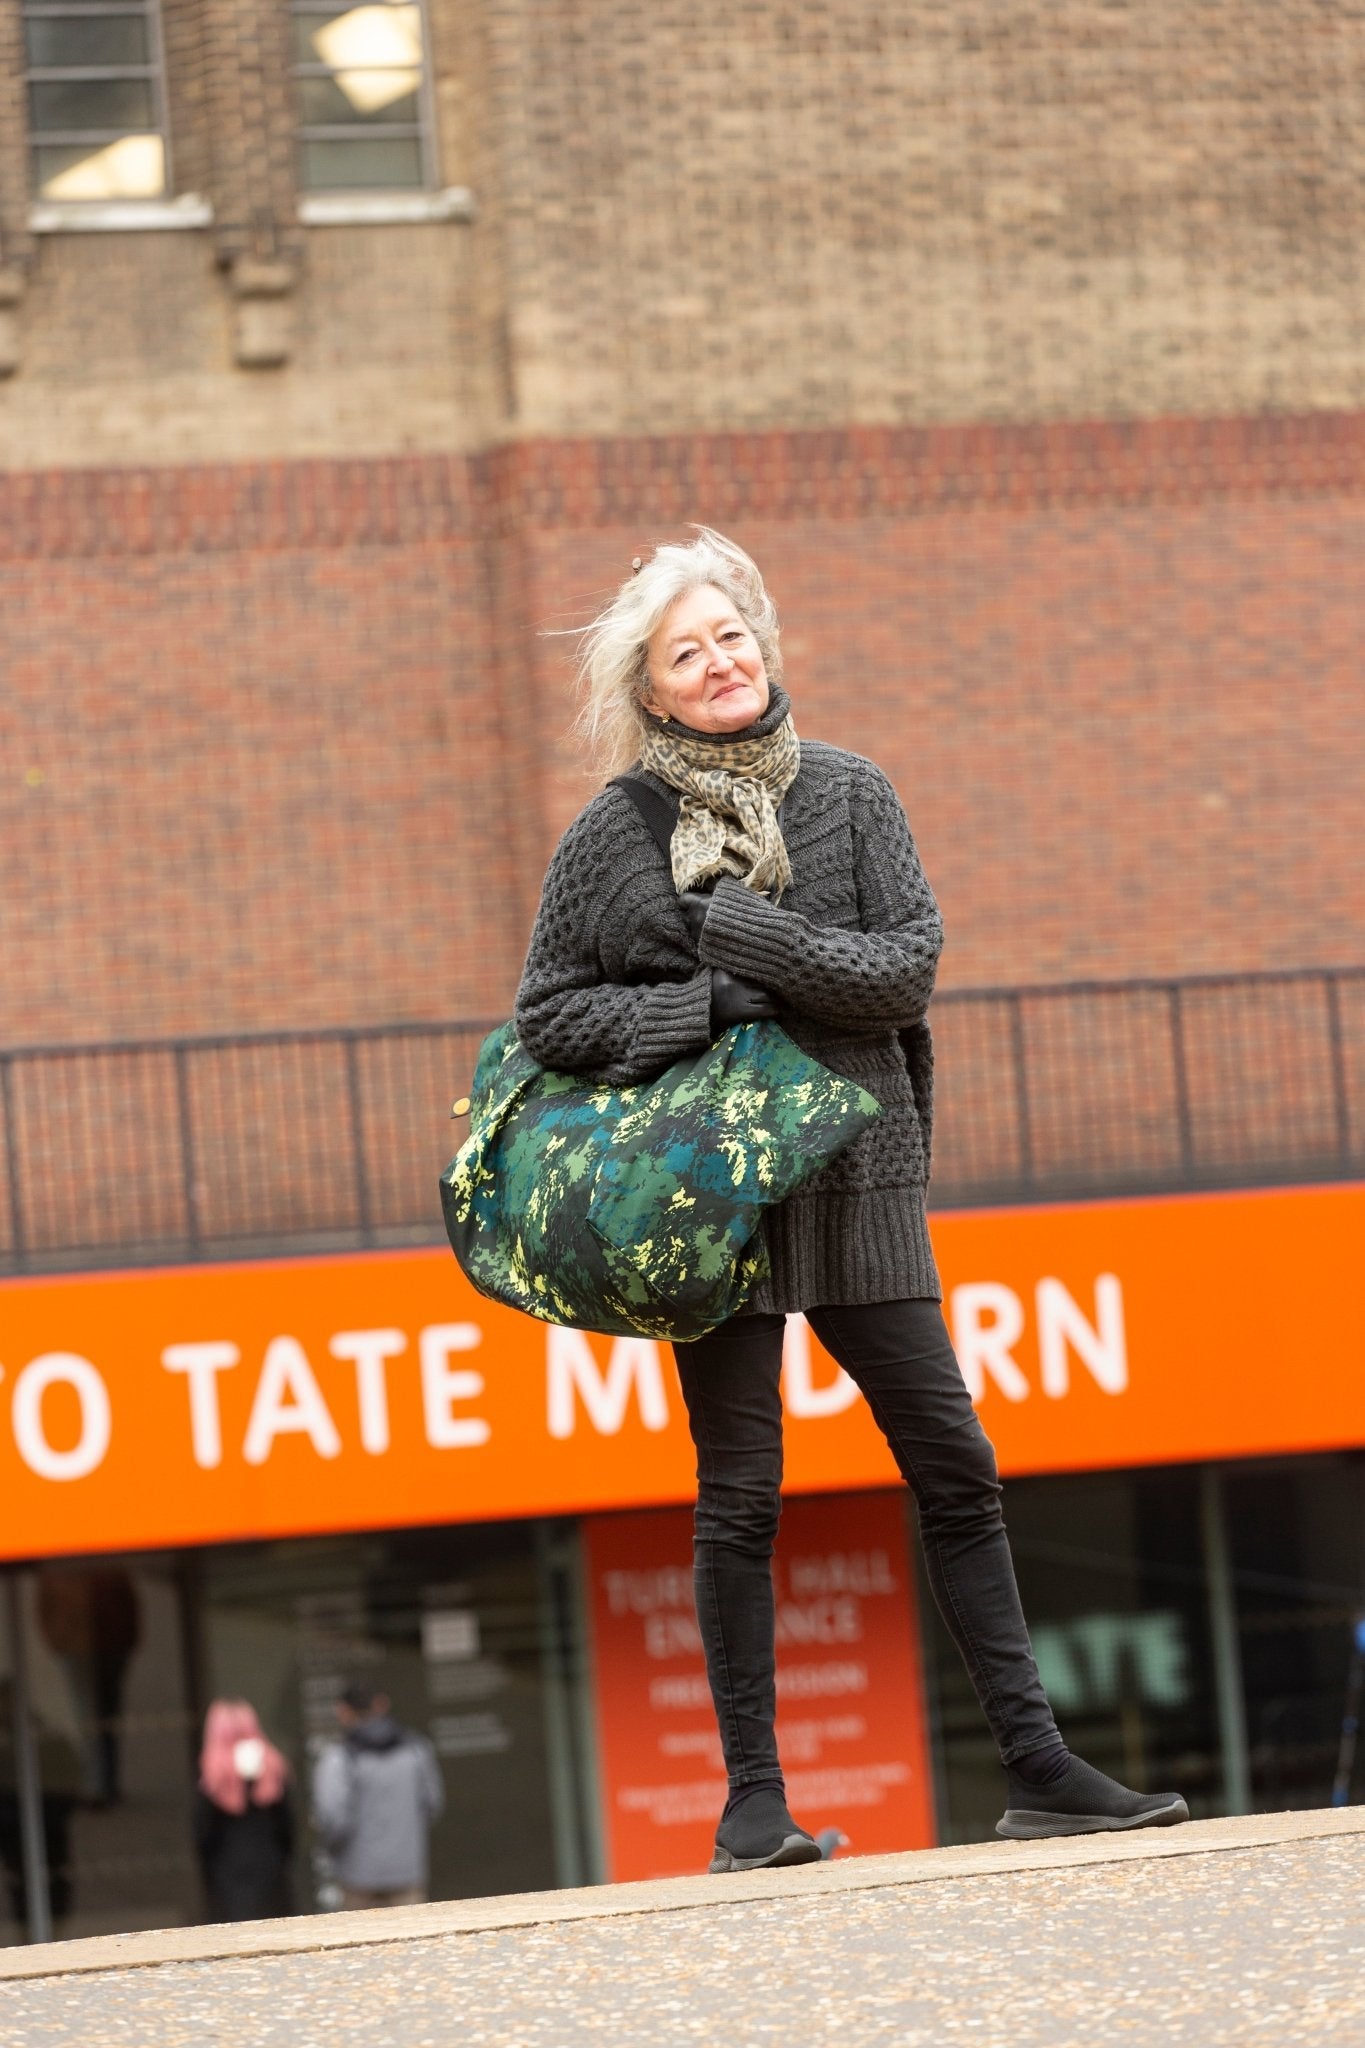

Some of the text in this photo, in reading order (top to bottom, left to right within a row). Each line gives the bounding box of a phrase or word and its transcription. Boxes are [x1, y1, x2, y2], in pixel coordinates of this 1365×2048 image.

[0, 1272, 1128, 1482] O TATE MDRN
